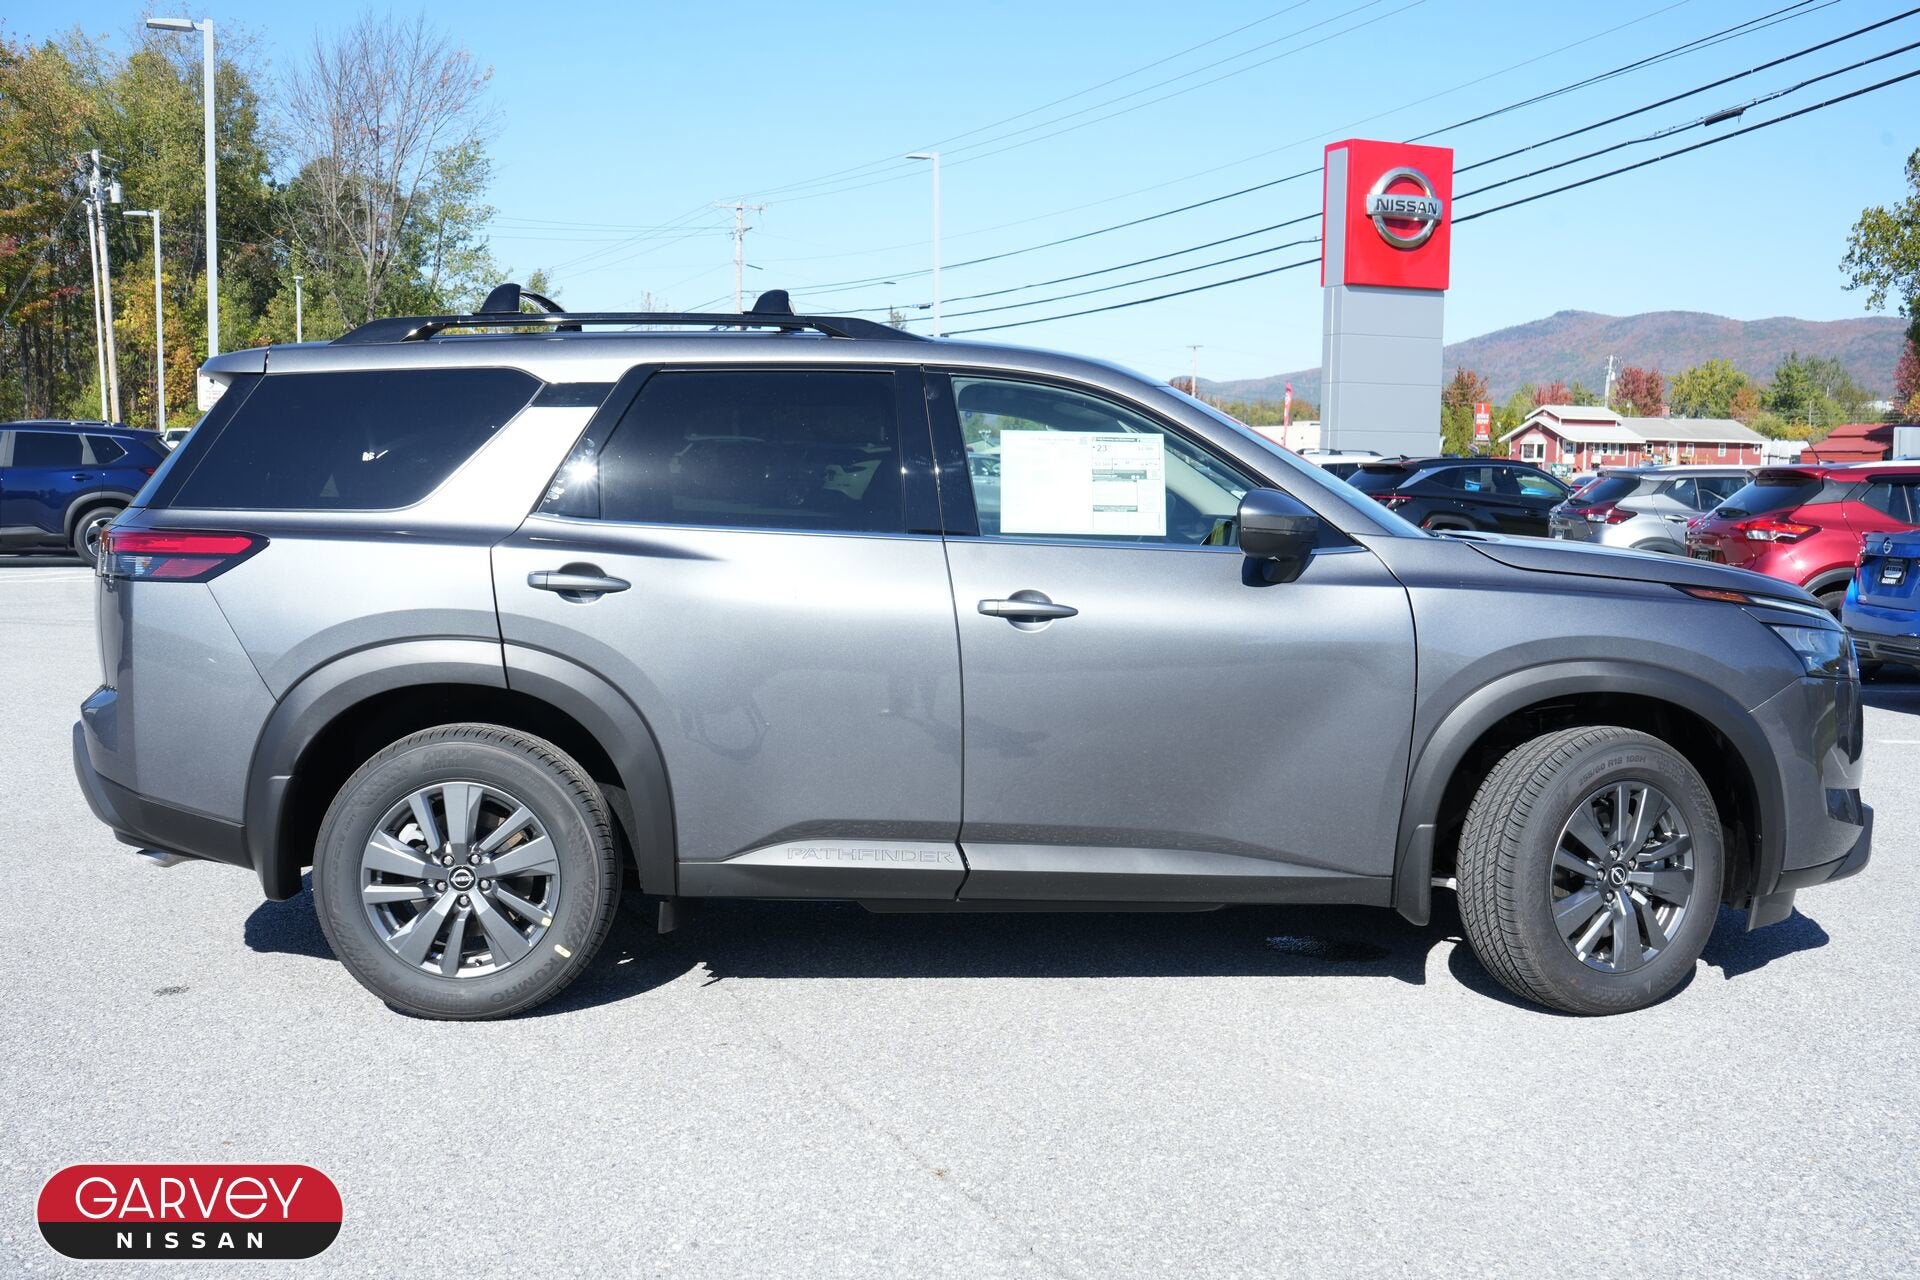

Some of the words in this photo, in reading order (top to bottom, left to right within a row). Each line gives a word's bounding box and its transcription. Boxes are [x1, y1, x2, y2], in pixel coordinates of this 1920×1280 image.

[1376, 198, 1438, 215] NISSAN
[786, 847, 956, 864] PATHFINDER
[488, 957, 560, 1003] KUMHO
